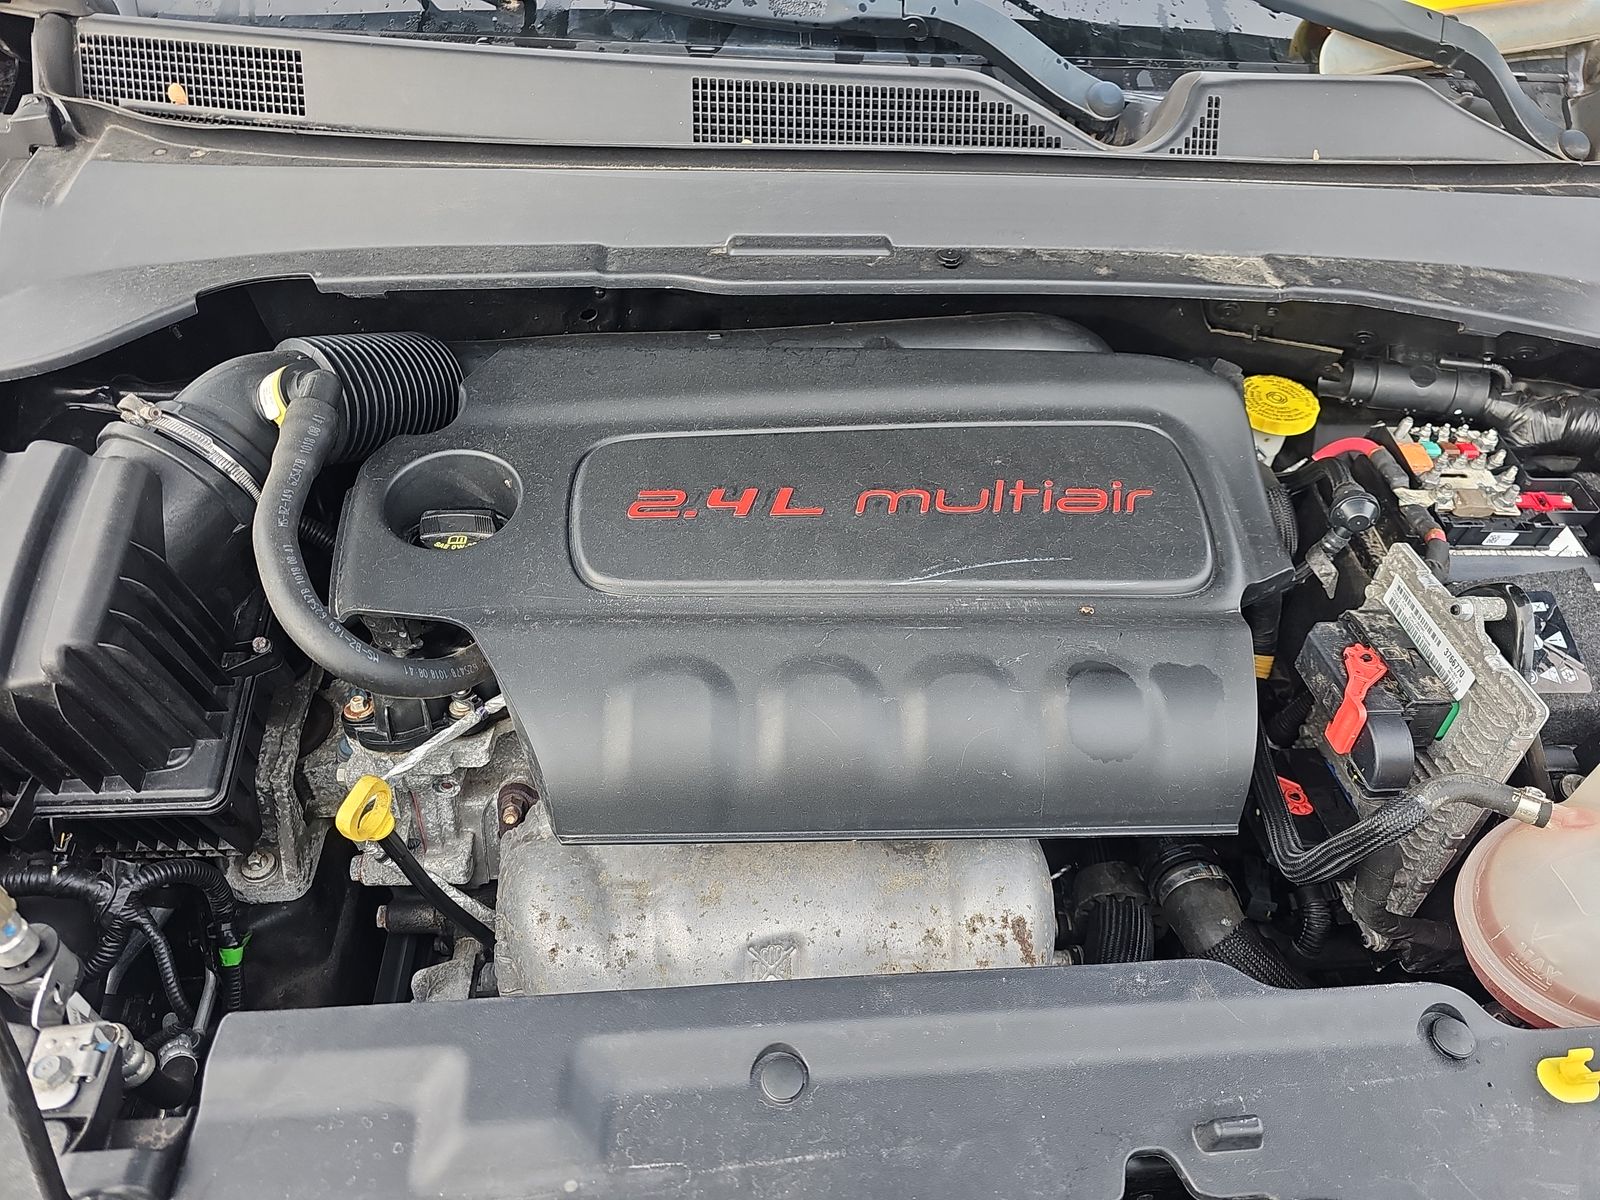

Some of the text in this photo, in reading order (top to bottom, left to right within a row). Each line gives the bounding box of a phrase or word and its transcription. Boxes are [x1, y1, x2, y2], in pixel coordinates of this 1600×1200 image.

[288, 458, 307, 486] 62547B
[300, 437, 316, 454] 1018
[856, 479, 1154, 514] multiair
[433, 541, 451, 550] SAE
[290, 566, 306, 585] 1018
[300, 587, 328, 619] 62547B
[430, 669, 448, 680] 1018
[1443, 647, 1466, 678] 3766770
